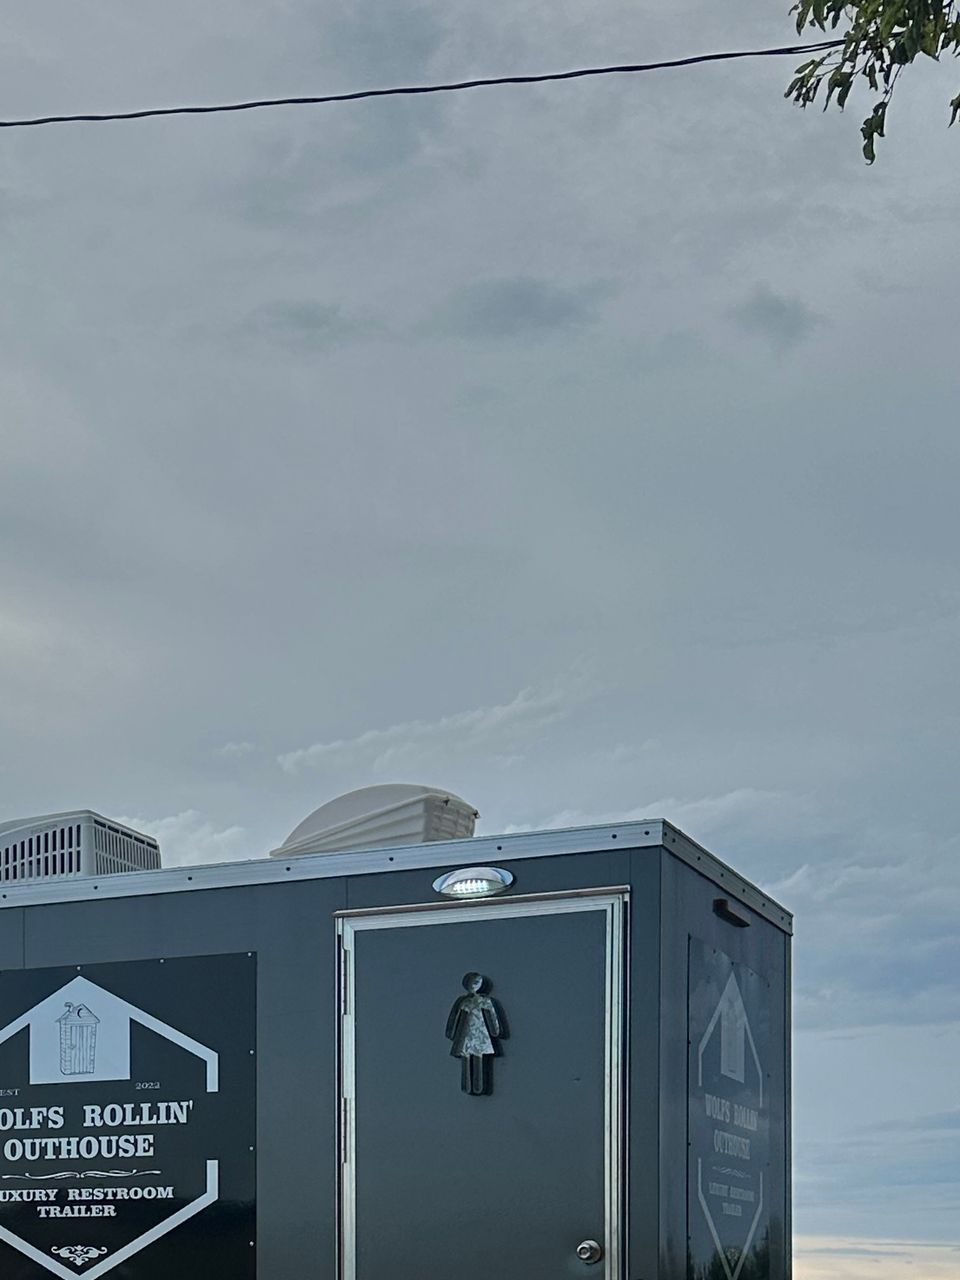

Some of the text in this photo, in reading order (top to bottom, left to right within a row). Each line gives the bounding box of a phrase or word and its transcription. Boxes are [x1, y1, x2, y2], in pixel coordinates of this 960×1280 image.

[0, 1088, 21, 1097] EST
[83, 1100, 194, 1128] ROLLIN'
[3, 1134, 155, 1161] OUTHOUSE
[67, 1186, 175, 1201] RESTROOM
[37, 1204, 117, 1218] TRAILER
